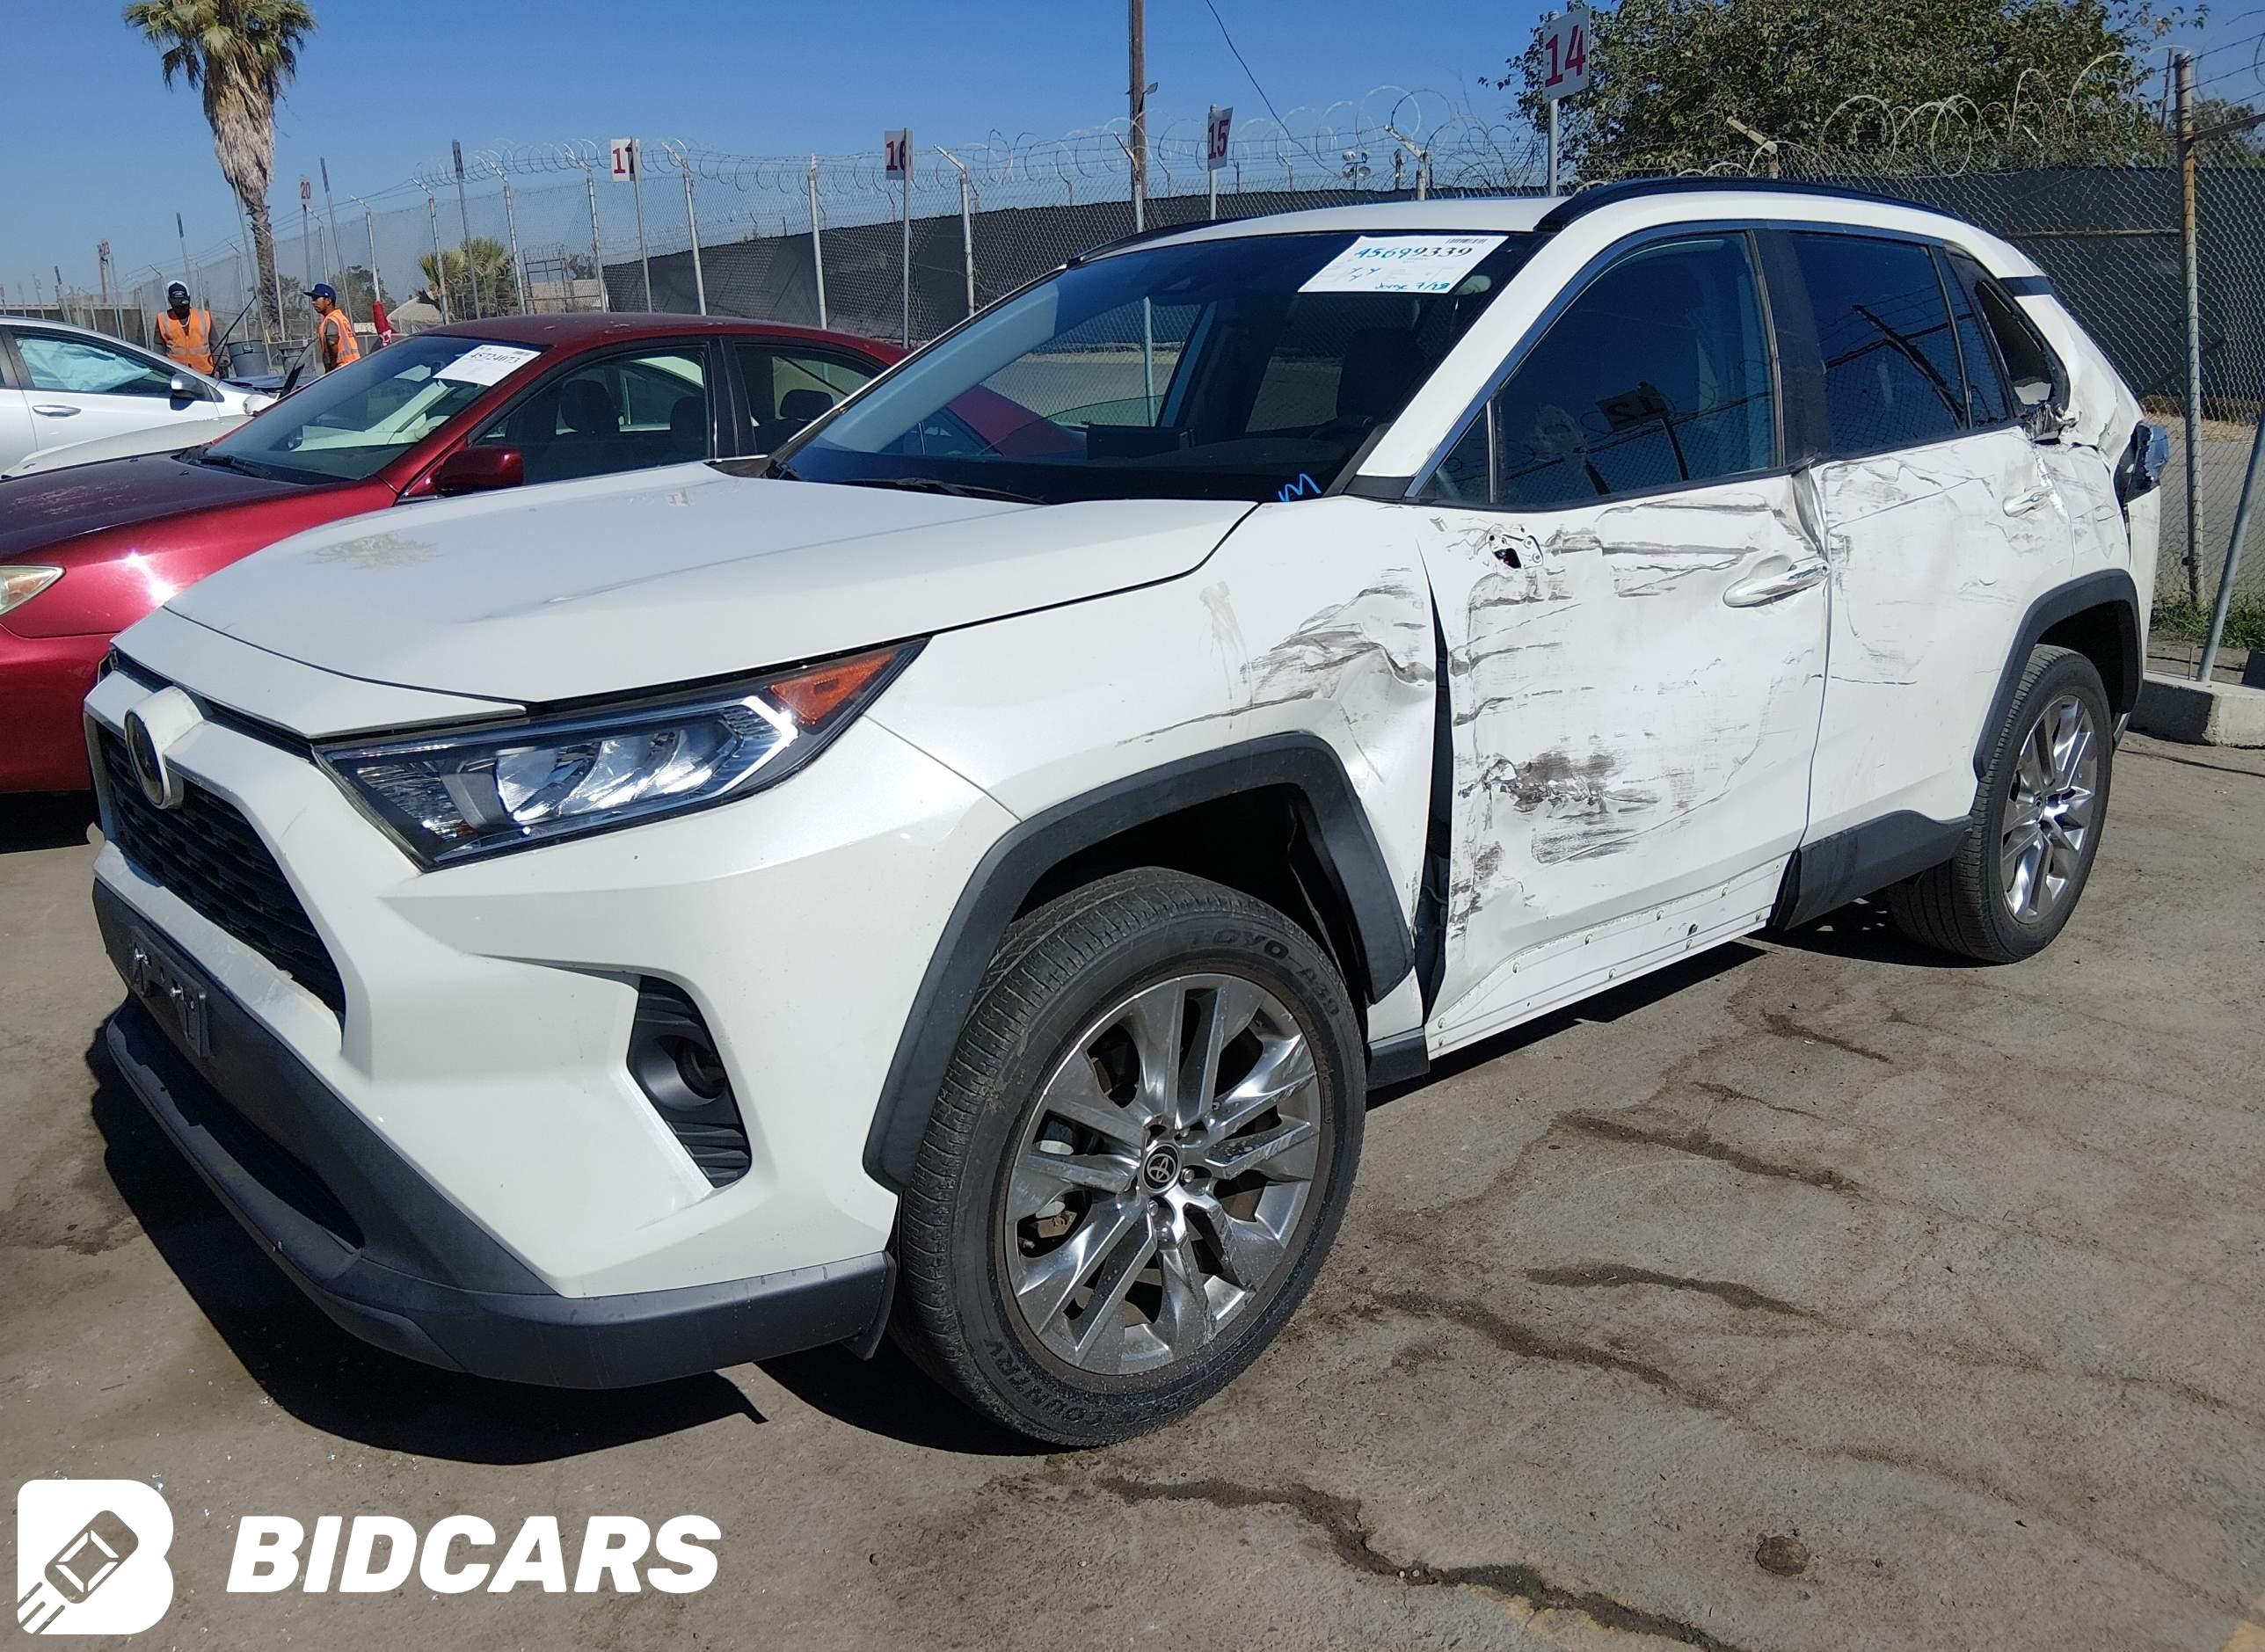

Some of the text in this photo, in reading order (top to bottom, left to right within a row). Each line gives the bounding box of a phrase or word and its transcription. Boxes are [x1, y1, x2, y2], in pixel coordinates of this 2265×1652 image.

[1545, 25, 1585, 87] 14
[1208, 120, 1229, 159] 15
[301, 181, 311, 200] 20
[1355, 247, 1474, 259] 45699339
